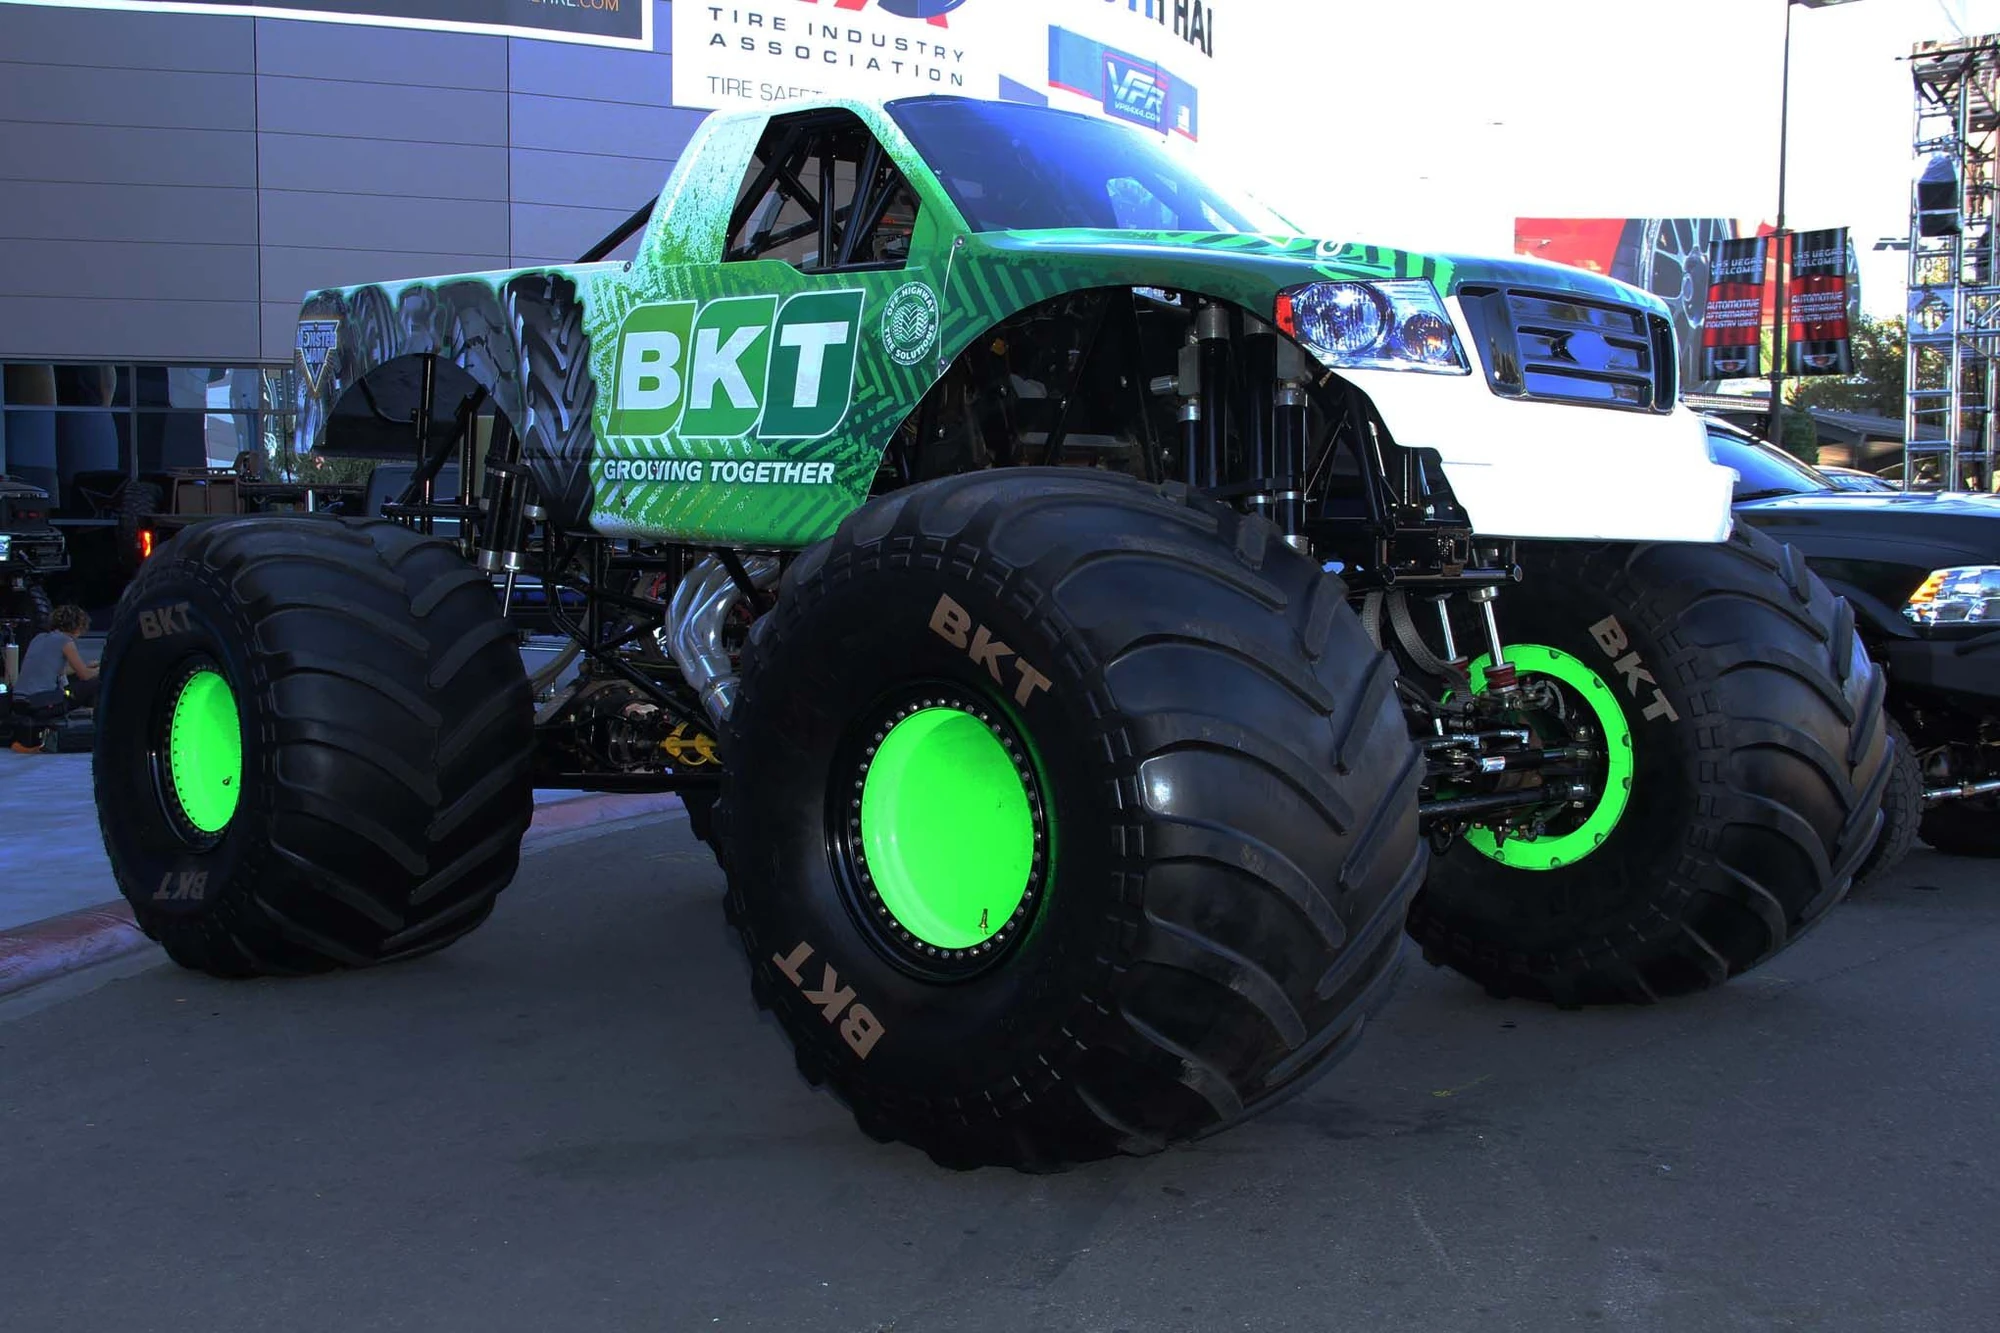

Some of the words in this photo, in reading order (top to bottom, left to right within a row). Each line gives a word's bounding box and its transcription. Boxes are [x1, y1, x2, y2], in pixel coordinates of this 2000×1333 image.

[708, 7, 786, 31] TIRE
[808, 22, 964, 62] INDUSTRY
[709, 33, 963, 86] ASSOCIATION
[707, 75, 754, 99] TIRE
[887, 286, 935, 316] OFF-HIGHWAY
[1707, 299, 1760, 310] AUTOMOTIVE
[1791, 291, 1843, 304] AUTOMOTIVE
[884, 325, 896, 352] TIRE
[895, 324, 935, 360] SOLUTIONS
[616, 320, 850, 410] BKT
[604, 459, 702, 482] GROWING
[710, 461, 835, 484] TOGETHER
[139, 601, 191, 639] BKT
[928, 592, 1054, 707] BKT
[1588, 614, 1680, 722] BKT
[152, 871, 209, 901] BKT
[771, 940, 886, 1060] BKT
